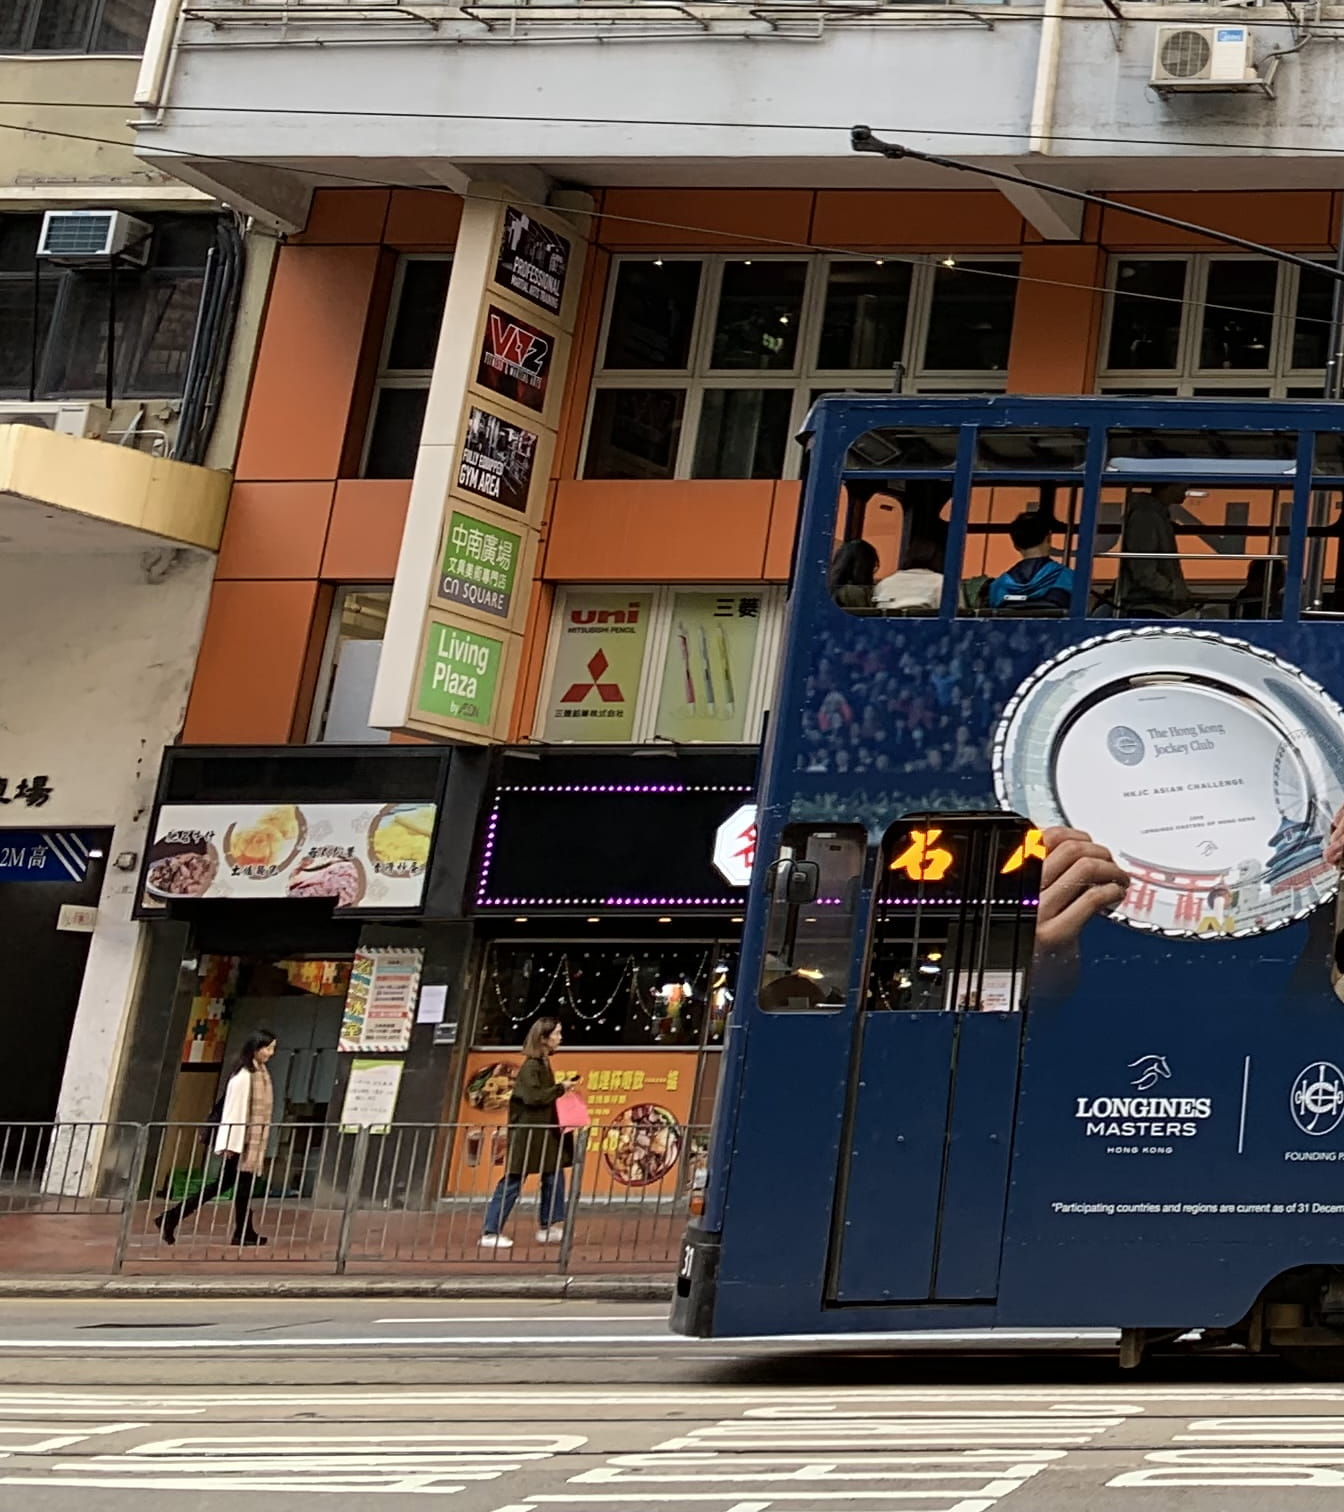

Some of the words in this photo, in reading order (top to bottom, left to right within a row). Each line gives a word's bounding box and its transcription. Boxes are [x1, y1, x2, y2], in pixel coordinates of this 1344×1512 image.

[459, 464, 479, 489] GYM
[479, 471, 501, 498] AREA
[451, 523, 513, 571] 中南廣場
[462, 582, 505, 610] SQUARE
[570, 601, 641, 625] uni
[714, 598, 761, 618] 三菱
[610, 626, 637, 634] PENCIL
[438, 629, 490, 676] Living
[432, 662, 478, 699] Plaza
[1147, 727, 1168, 739] The
[1170, 725, 1198, 738] Hong
[1199, 723, 1226, 736] Kong
[1154, 743, 1189, 758] Jockey
[1190, 739, 1215, 752] Club
[0, 775, 54, 808] 場
[1123, 790, 1150, 798] HKJC
[1153, 785, 1184, 795] ASIAN
[1187, 778, 1245, 791] CHALLENGE
[28, 845, 49, 869] 高
[1075, 1096, 1211, 1119] LONGINES
[1086, 1122, 1197, 1137] MASTERS
[1107, 1146, 1139, 1154] HONG
[1142, 1146, 1173, 1154] KONG
[1285, 1151, 1337, 1161] FOUNDING
[1116, 1202, 1160, 1214] countries
[1162, 1202, 1181, 1213] and
[1183, 1202, 1218, 1216] regions
[1219, 1204, 1235, 1213] are
[1236, 1203, 1270, 1214] current
[1271, 1204, 1284, 1213] as
[1286, 1202, 1297, 1214] of
[1297, 1203, 1310, 1213] 31
[0, 1435, 591, 1494] AND
[492, 1404, 1148, 1512] ELECTRIC
